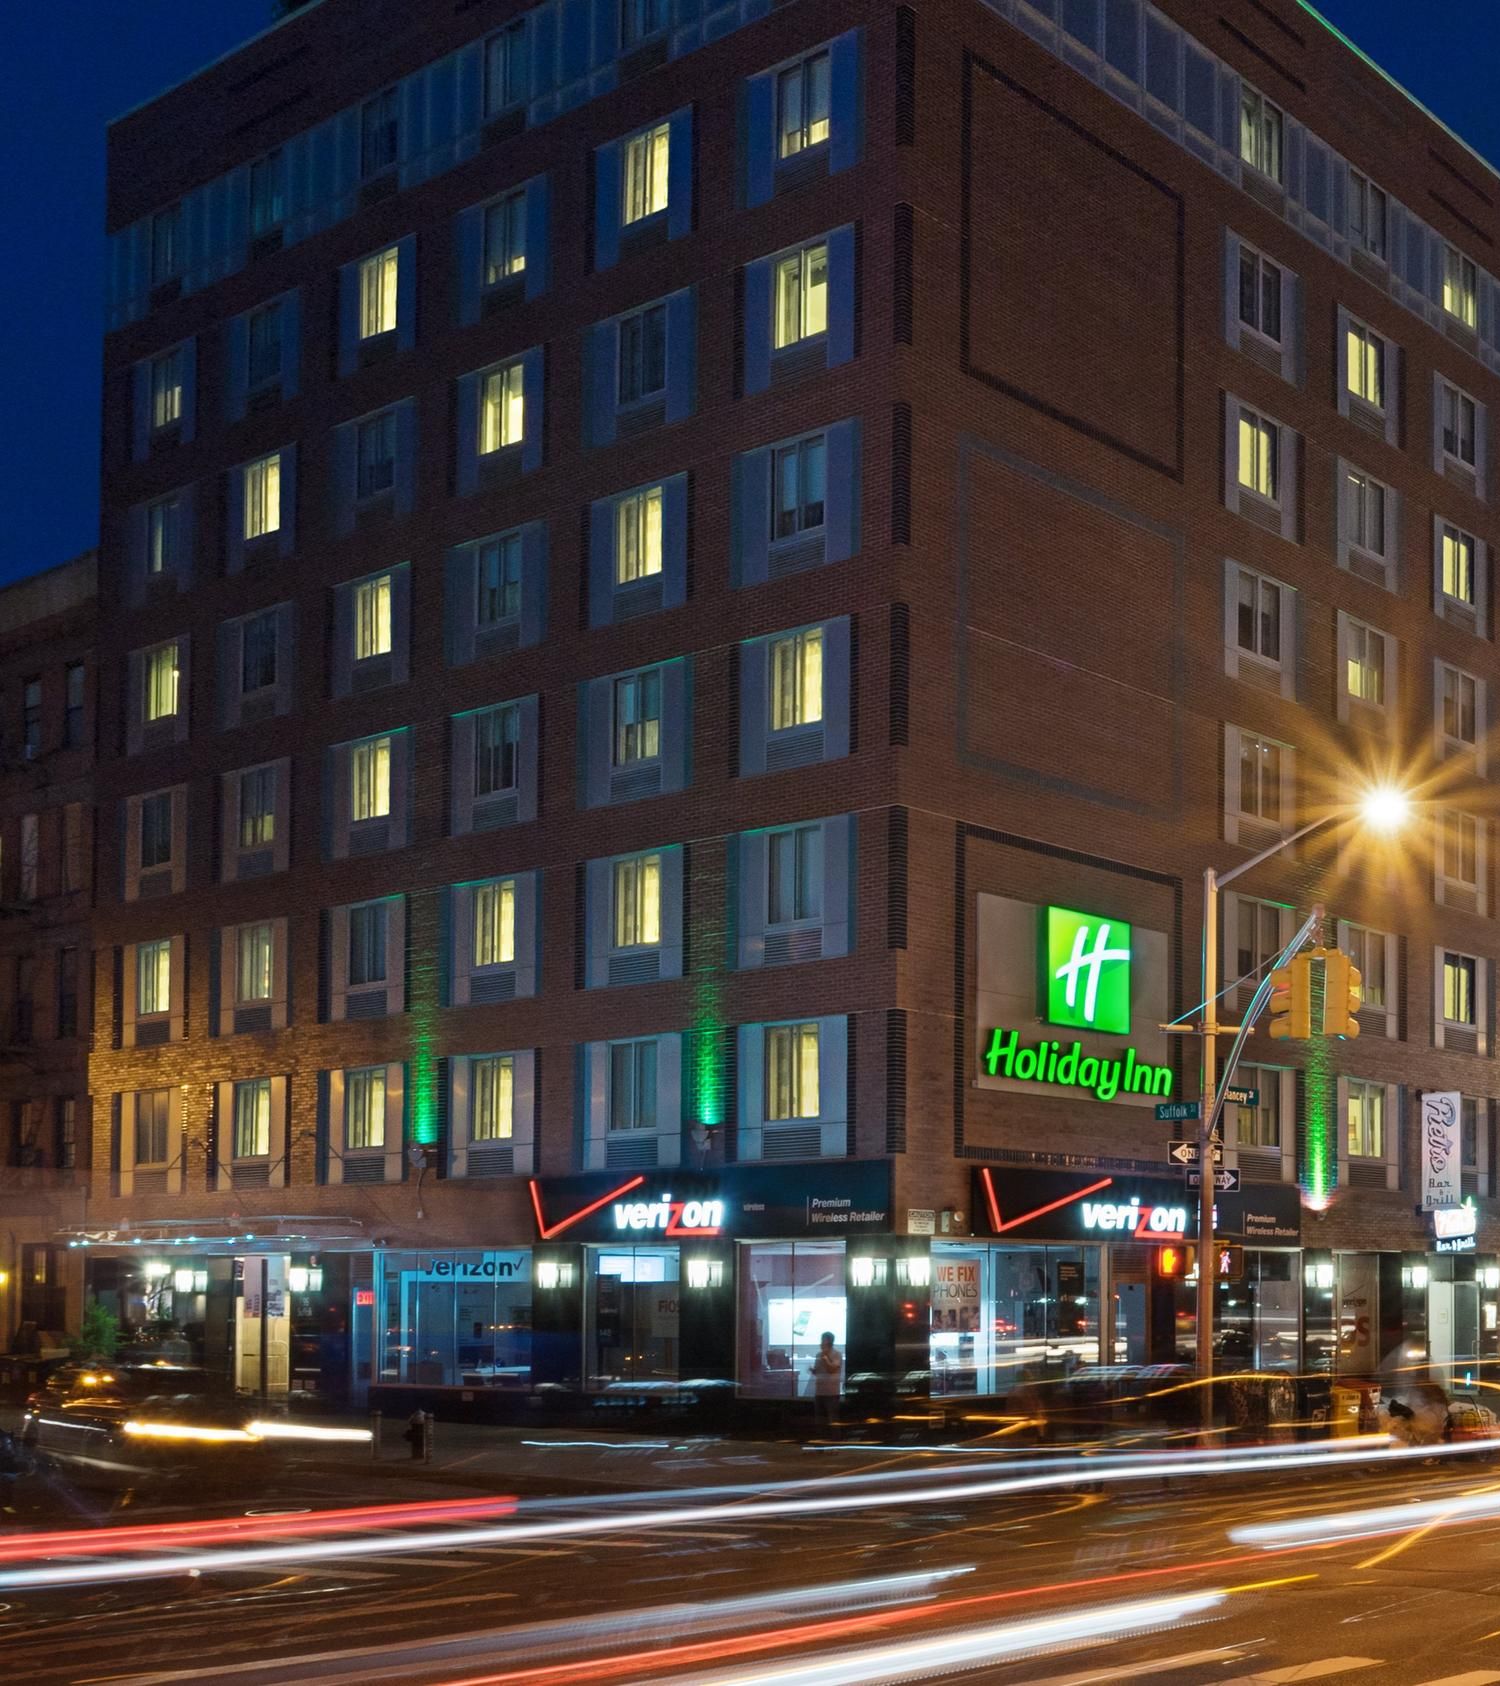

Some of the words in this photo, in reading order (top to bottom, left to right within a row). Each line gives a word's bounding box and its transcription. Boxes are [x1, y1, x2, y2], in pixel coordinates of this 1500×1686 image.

[986, 1028, 1121, 1100] Holiday
[1123, 1047, 1173, 1097] Inn
[1159, 1105, 1188, 1119] Suffolk
[1426, 1096, 1457, 1174] Retro
[1428, 1178, 1453, 1188] Bar
[811, 1197, 851, 1208] Premium
[1425, 1194, 1457, 1206] Grill
[614, 1193, 724, 1236] verizon
[811, 1211, 849, 1223] Wireless
[849, 1210, 886, 1222] Retailer
[1081, 1197, 1187, 1239] verizon
[1246, 1213, 1277, 1223] Premium
[1246, 1226, 1274, 1236] Wireless
[1274, 1227, 1299, 1237] Retailer
[425, 1258, 513, 1277] verizon
[936, 1265, 954, 1282] WE
[957, 1265, 976, 1282] FIX
[932, 1283, 978, 1298] PHONES
